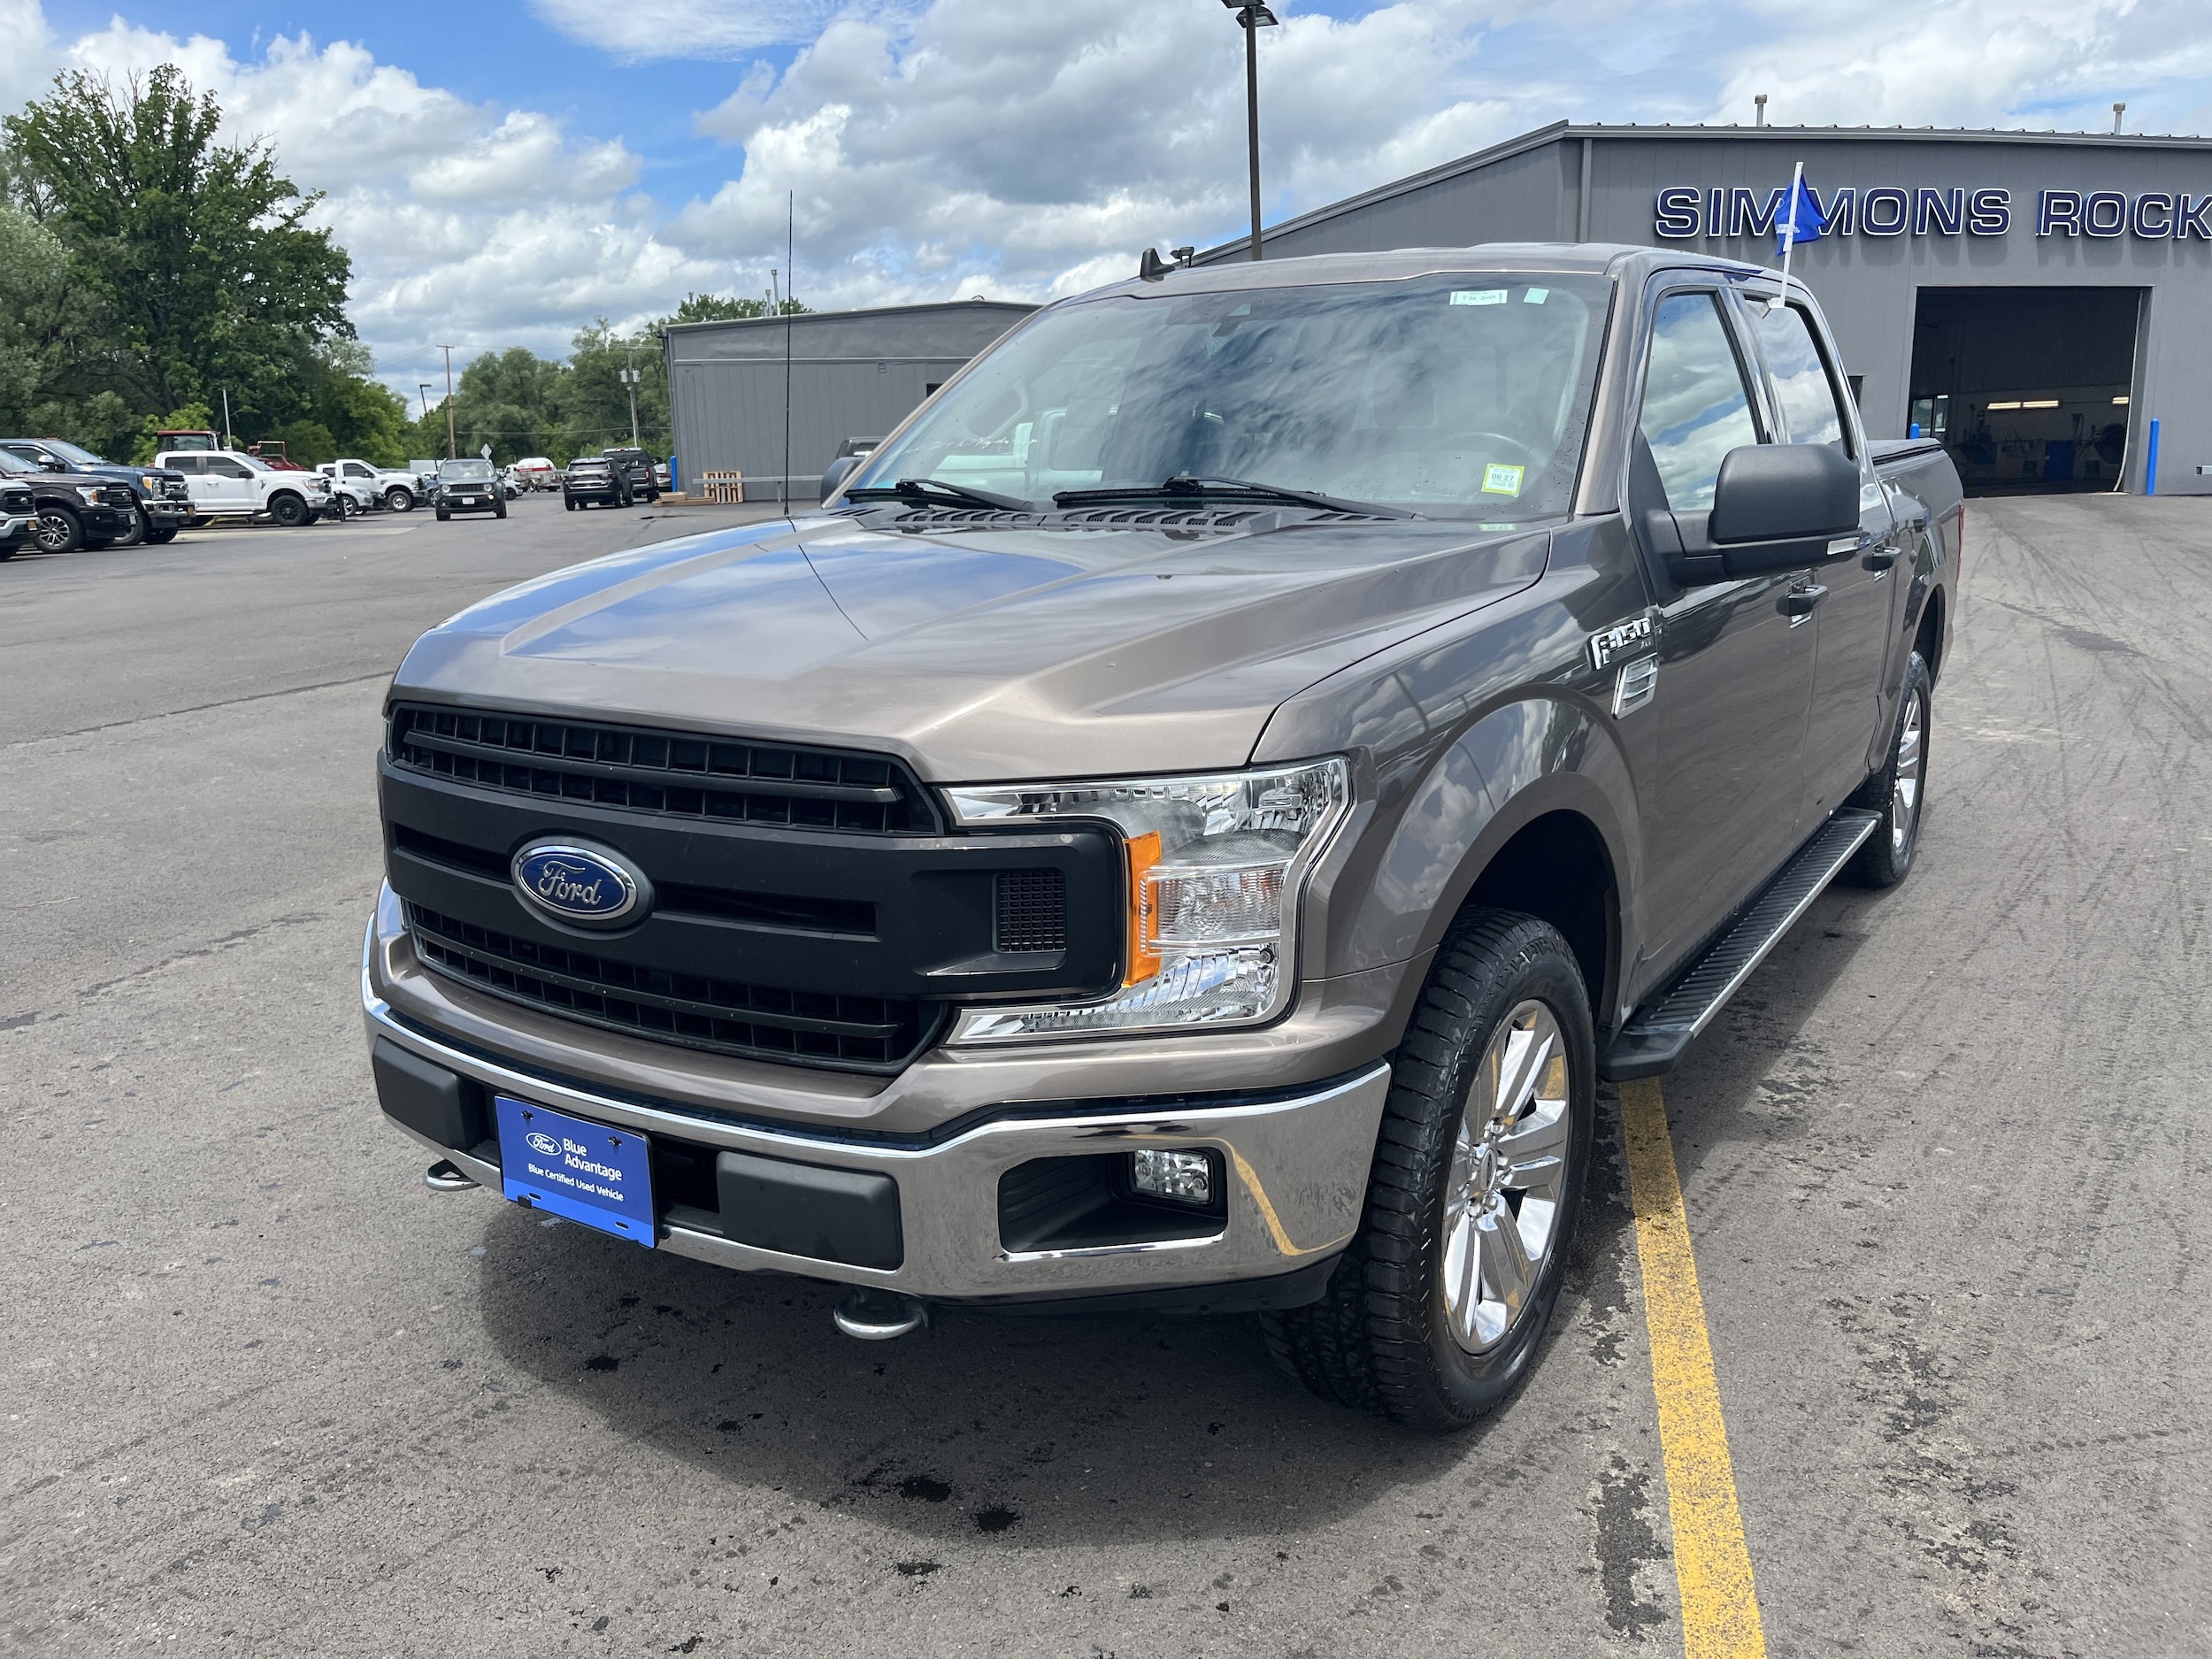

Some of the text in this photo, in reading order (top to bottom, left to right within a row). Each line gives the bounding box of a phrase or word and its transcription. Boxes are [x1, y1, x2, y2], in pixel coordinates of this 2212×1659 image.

[1655, 186, 2212, 240] SIMMONS ROCK
[537, 860, 603, 906] Ford
[533, 1134, 557, 1153] Ford
[563, 1137, 588, 1156] Blue
[528, 1163, 624, 1202] Blue Certified Used Vehicle
[565, 1153, 623, 1181] Advantage
